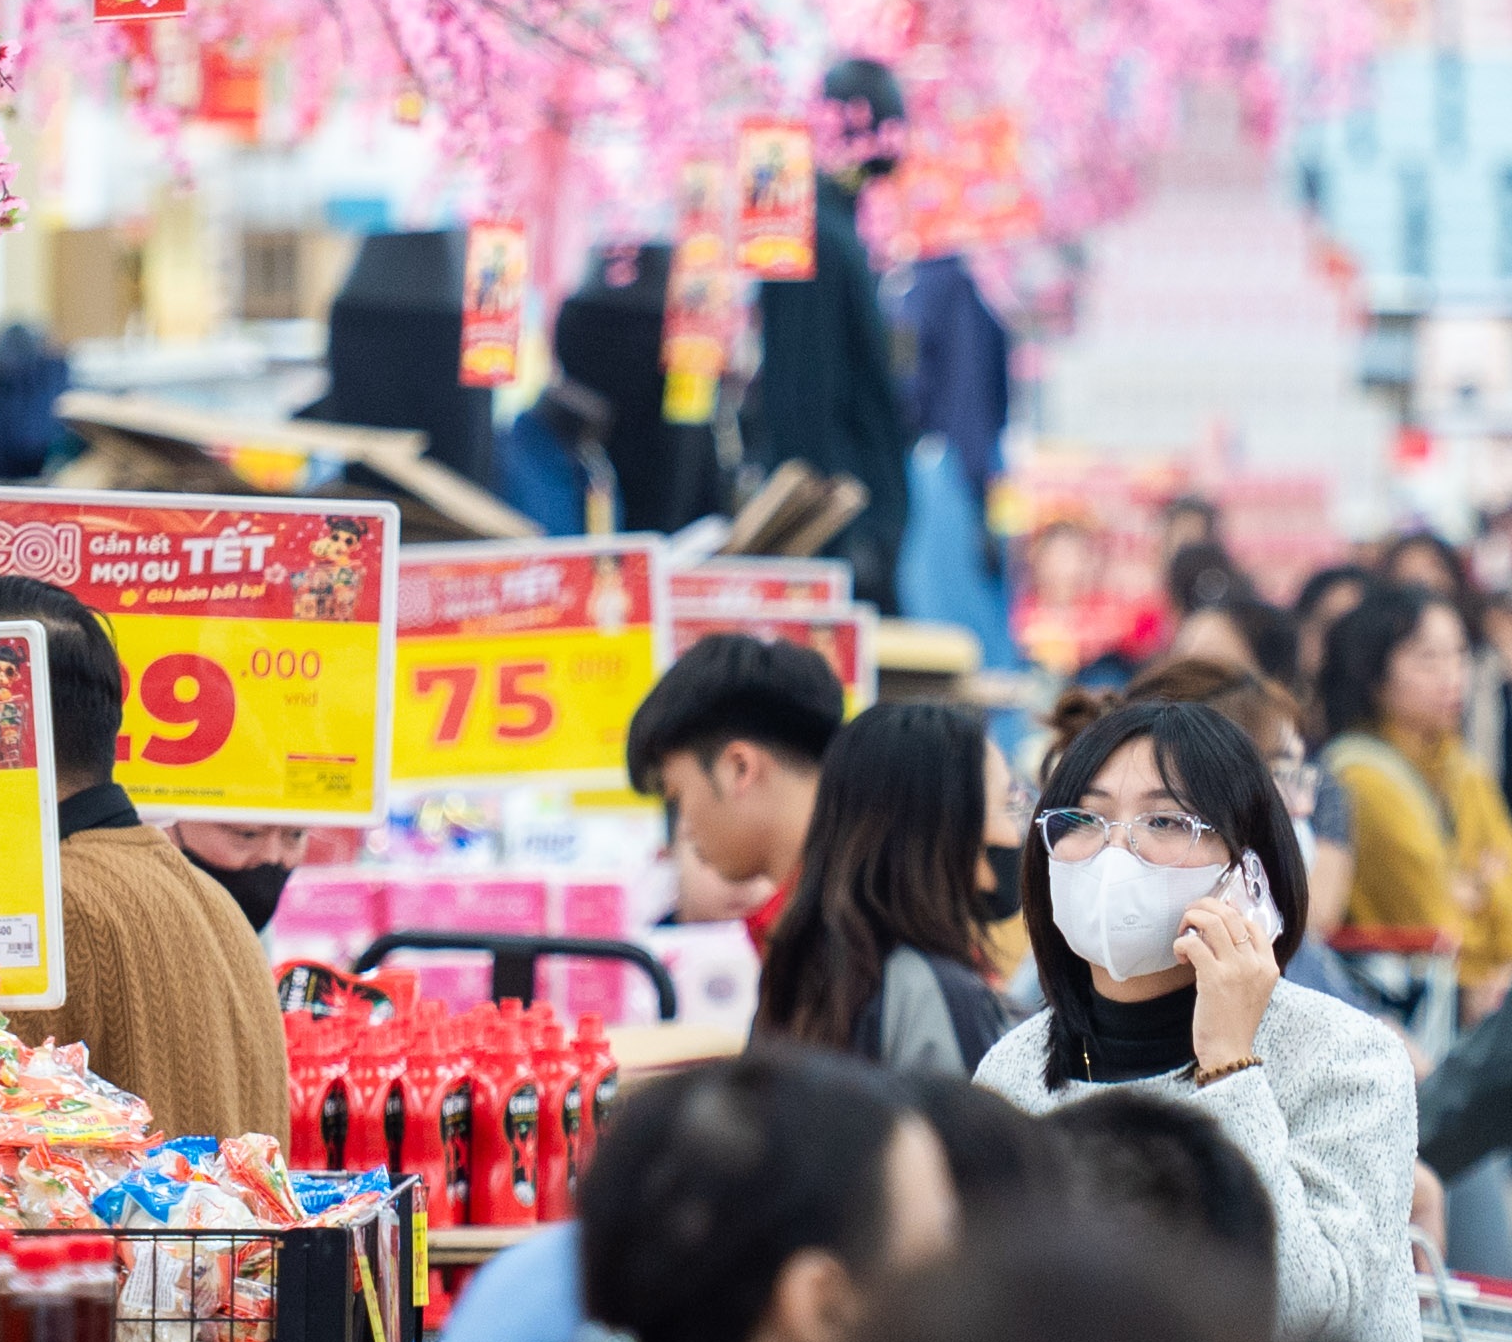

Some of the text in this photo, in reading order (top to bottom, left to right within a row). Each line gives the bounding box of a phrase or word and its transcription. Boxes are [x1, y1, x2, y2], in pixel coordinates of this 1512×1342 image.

[90, 531, 132, 556] Gắn
[135, 533, 171, 556] kết
[180, 520, 276, 575] TẾT
[90, 560, 181, 589] MỌI GU
[146, 583, 268, 604] Giá luôn bất bại
[240, 648, 322, 681] .000
[415, 662, 554, 741] 75
